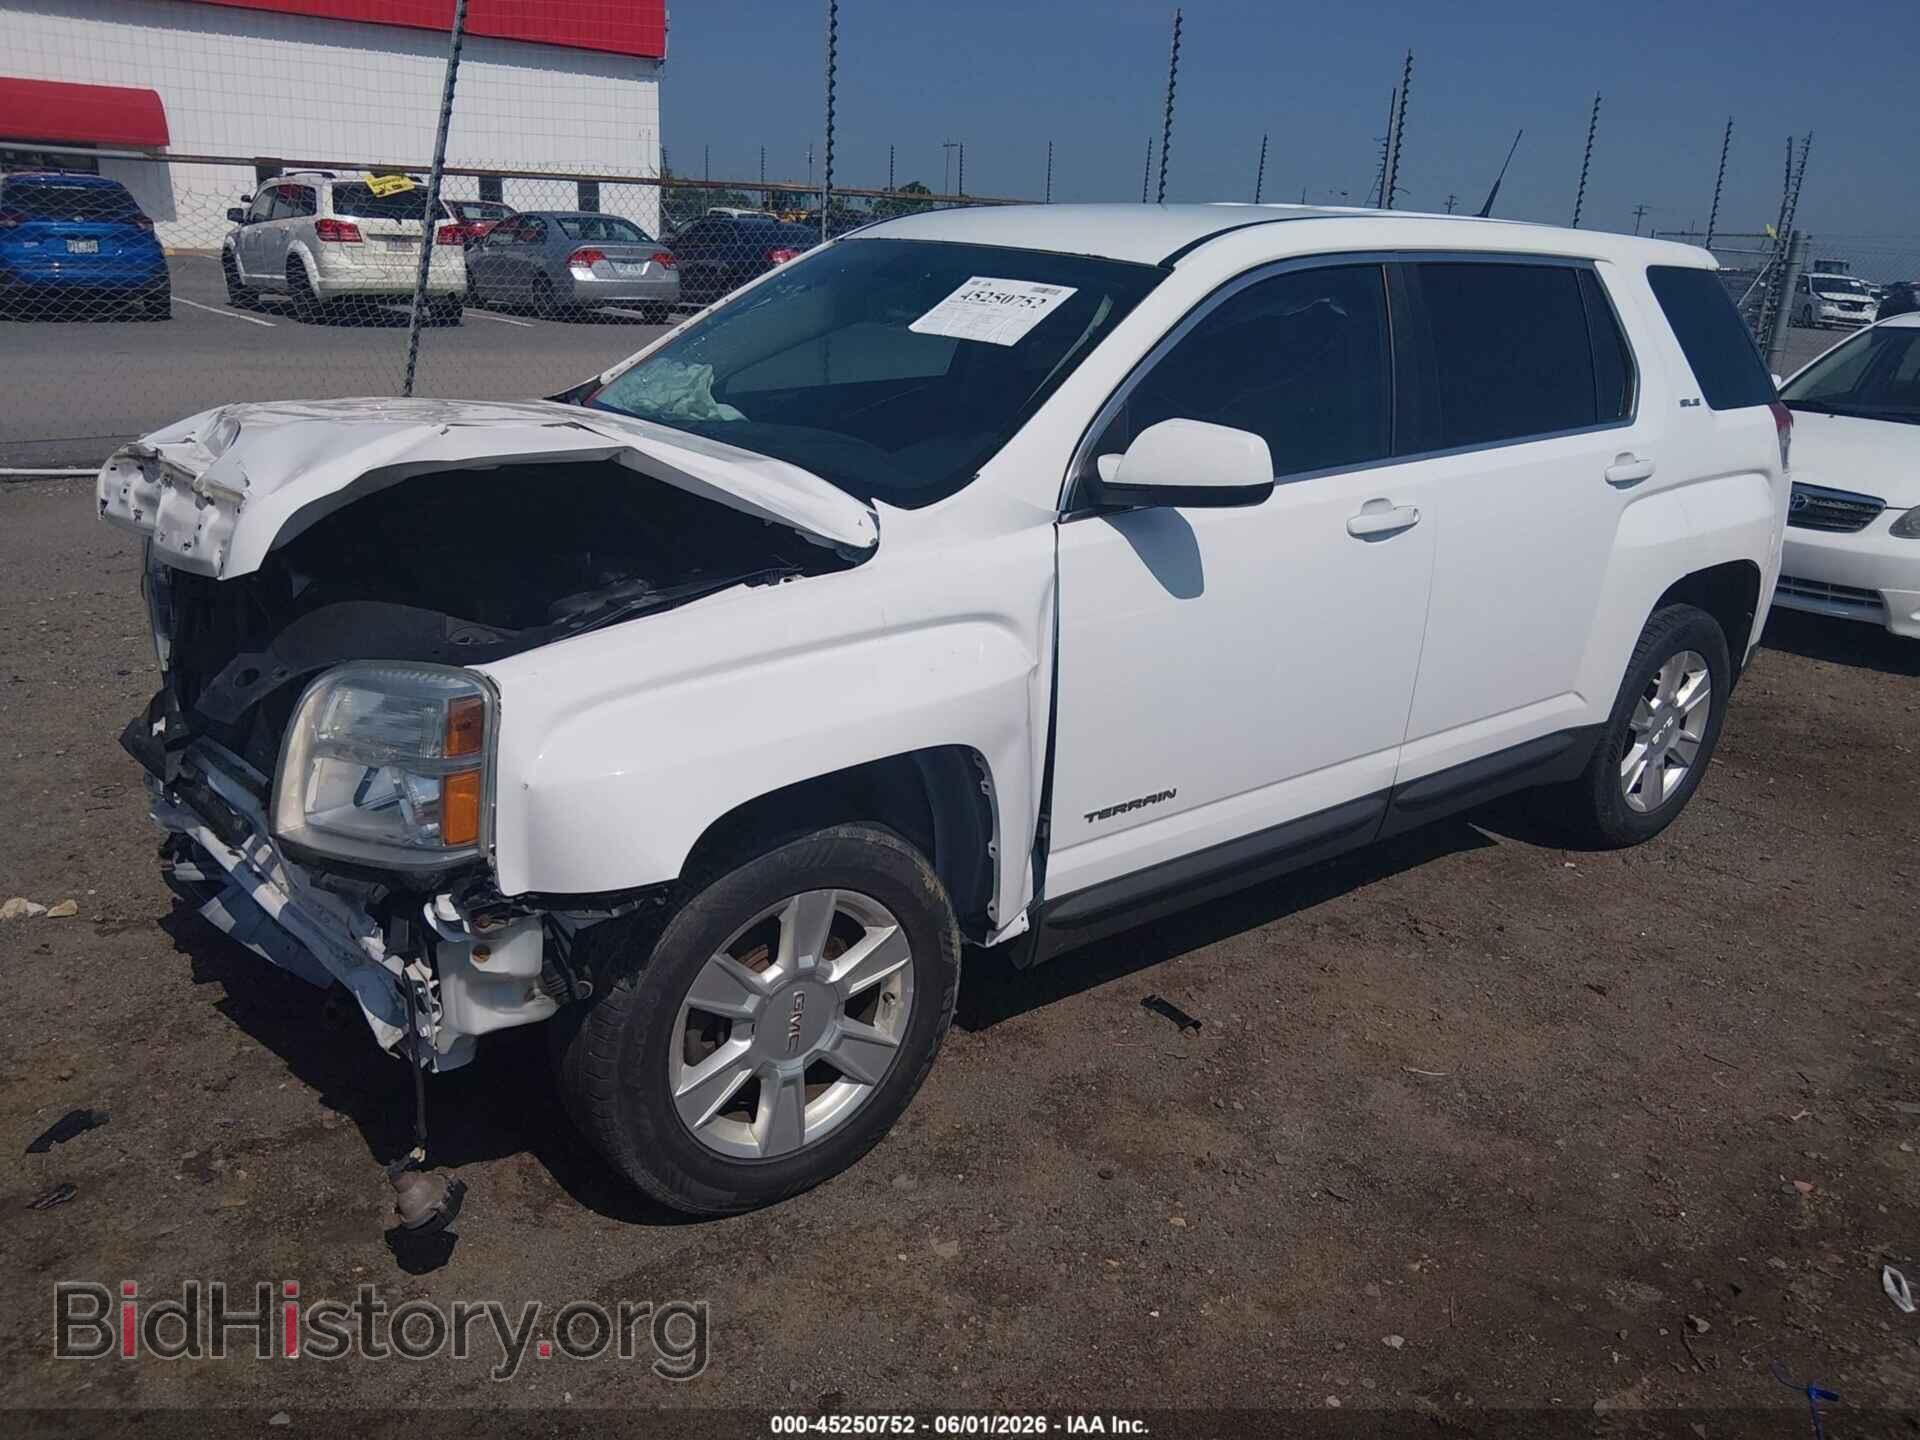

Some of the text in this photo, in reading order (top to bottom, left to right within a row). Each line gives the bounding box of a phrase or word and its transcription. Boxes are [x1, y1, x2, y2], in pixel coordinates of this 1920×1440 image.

[961, 290, 1048, 309] 45250752
[1083, 788, 1177, 823] TERRAIN
[785, 990, 806, 1051] GMC
